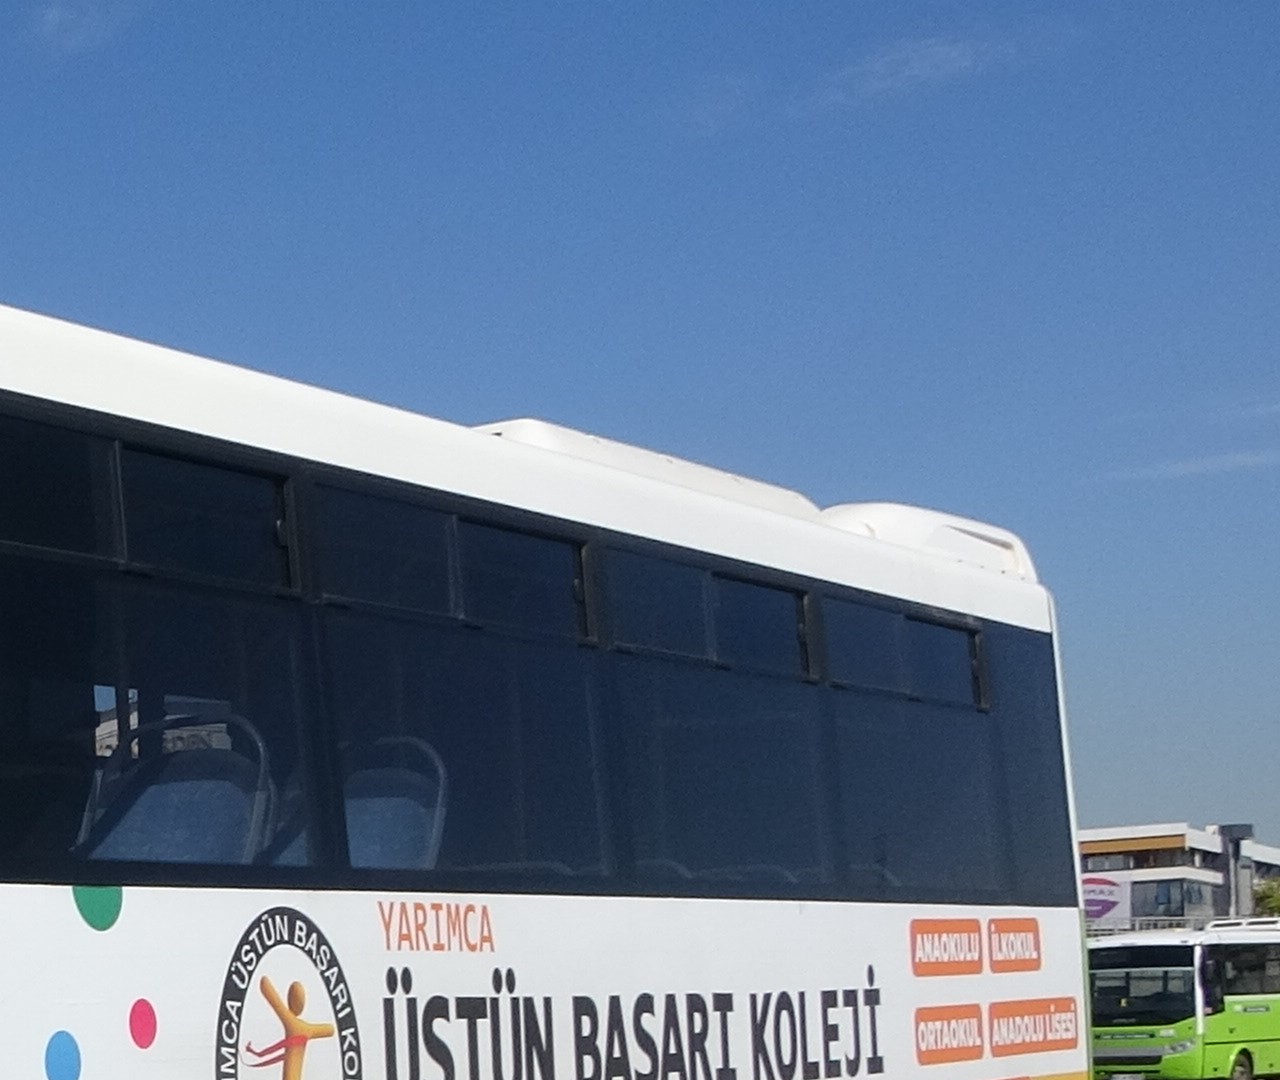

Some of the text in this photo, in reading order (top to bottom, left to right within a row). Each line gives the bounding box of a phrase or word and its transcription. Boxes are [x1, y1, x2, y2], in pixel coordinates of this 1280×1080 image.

[378, 901, 496, 953] YARIMCA
[915, 932, 980, 963] ANAOKULU
[990, 923, 1038, 962] İLKOKUL
[231, 914, 289, 989] ÜSTÜN
[918, 1018, 982, 1051] ORTAOKUL
[992, 1002, 1076, 1047] ANADOLU LİSESİ
